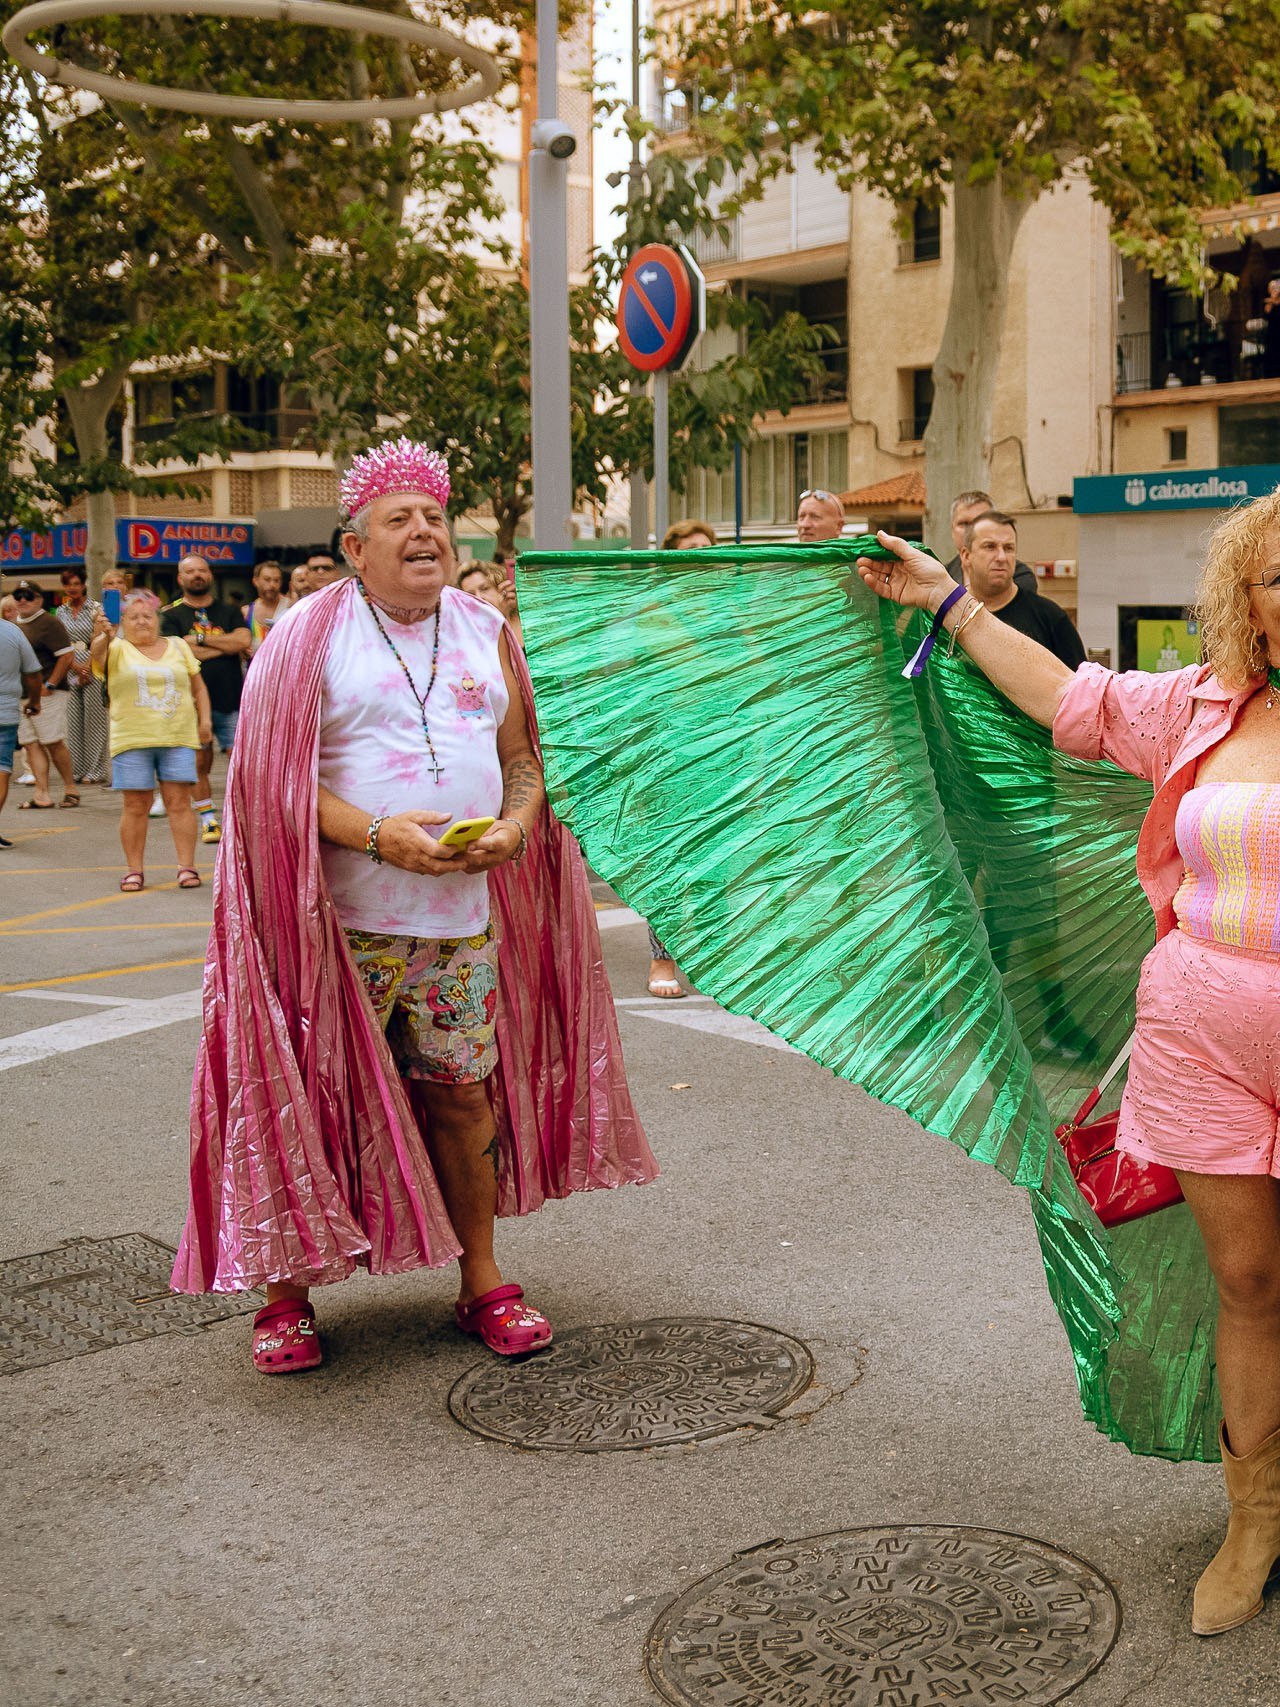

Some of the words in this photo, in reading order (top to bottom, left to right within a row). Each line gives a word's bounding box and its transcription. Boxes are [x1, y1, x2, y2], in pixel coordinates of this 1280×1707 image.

[1149, 476, 1248, 501] caixacallosa
[31, 530, 54, 559] DI
[926, 1560, 1038, 1620] RESIDUALES
